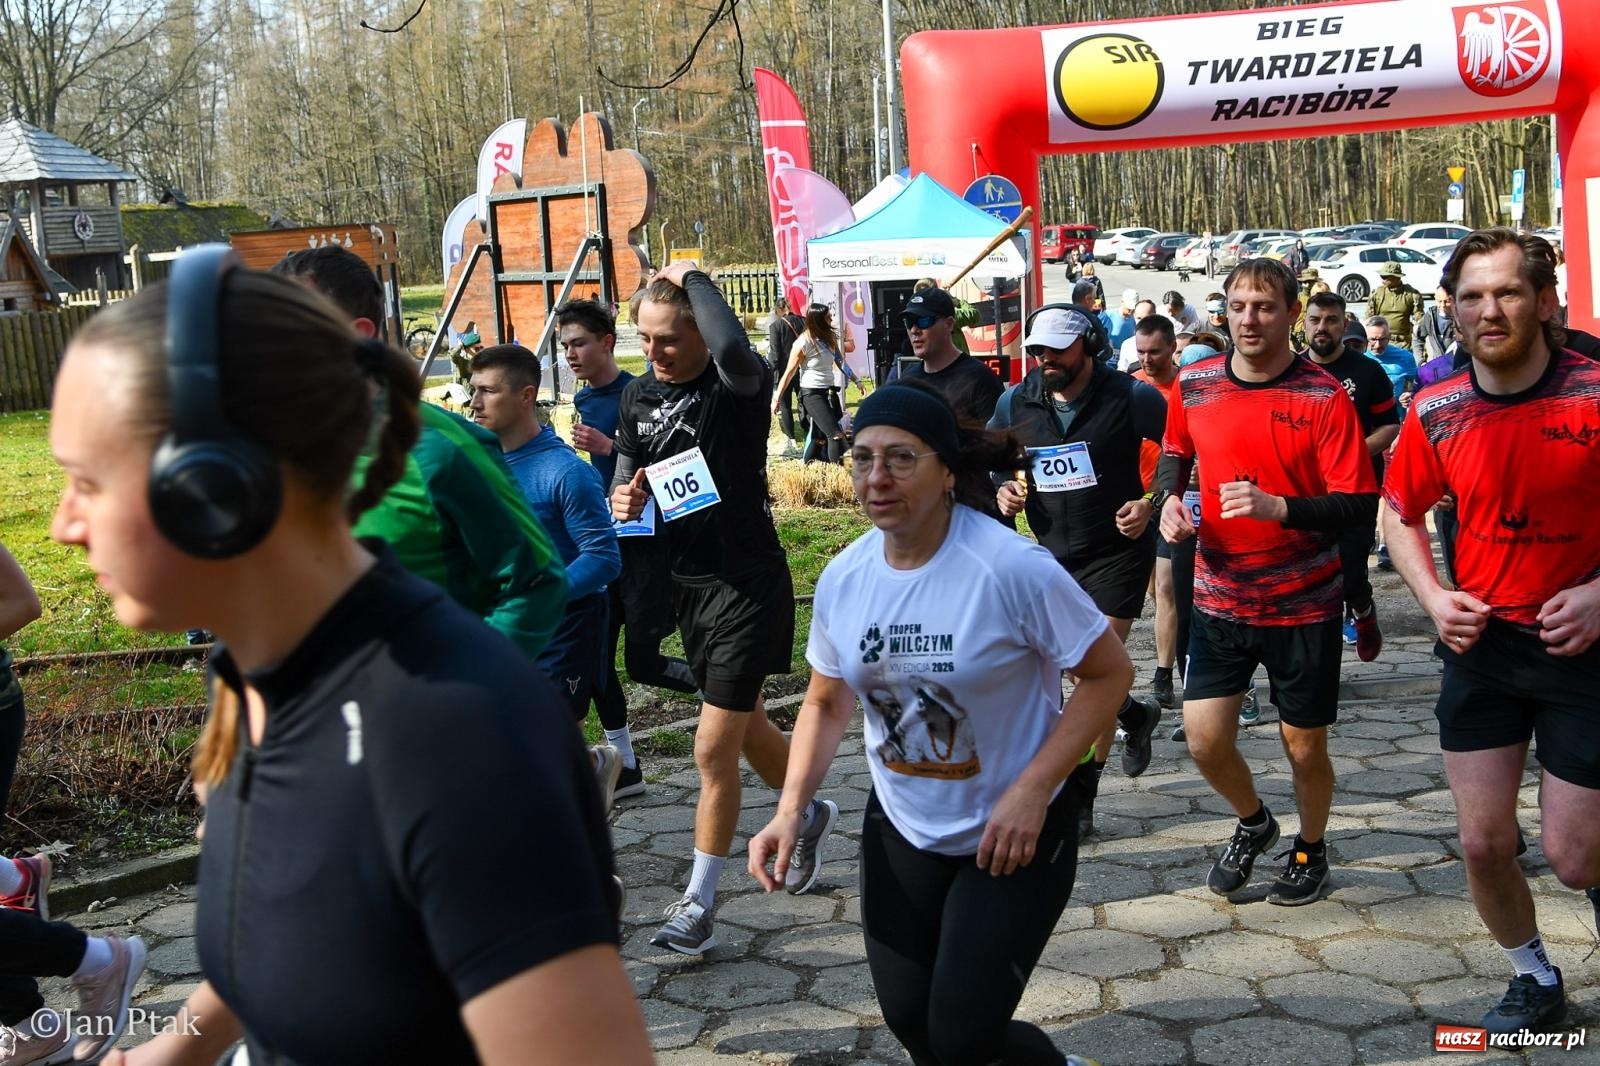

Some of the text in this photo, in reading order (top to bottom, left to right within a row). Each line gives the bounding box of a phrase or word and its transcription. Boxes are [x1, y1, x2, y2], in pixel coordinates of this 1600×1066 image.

[1256, 16, 1344, 41] BIEG
[1103, 43, 1160, 64] SIR
[1187, 43, 1423, 86] TWARDZIELA
[1210, 83, 1399, 122] RACIBÓRZ
[822, 255, 898, 270] PersonalBest
[1040, 457, 1079, 477] 102
[663, 471, 700, 502] 106
[889, 623, 922, 635] TROPEM
[889, 634, 953, 653] WILCZYM
[903, 662, 931, 673] EDYCJA
[932, 661, 954, 673] 2026
